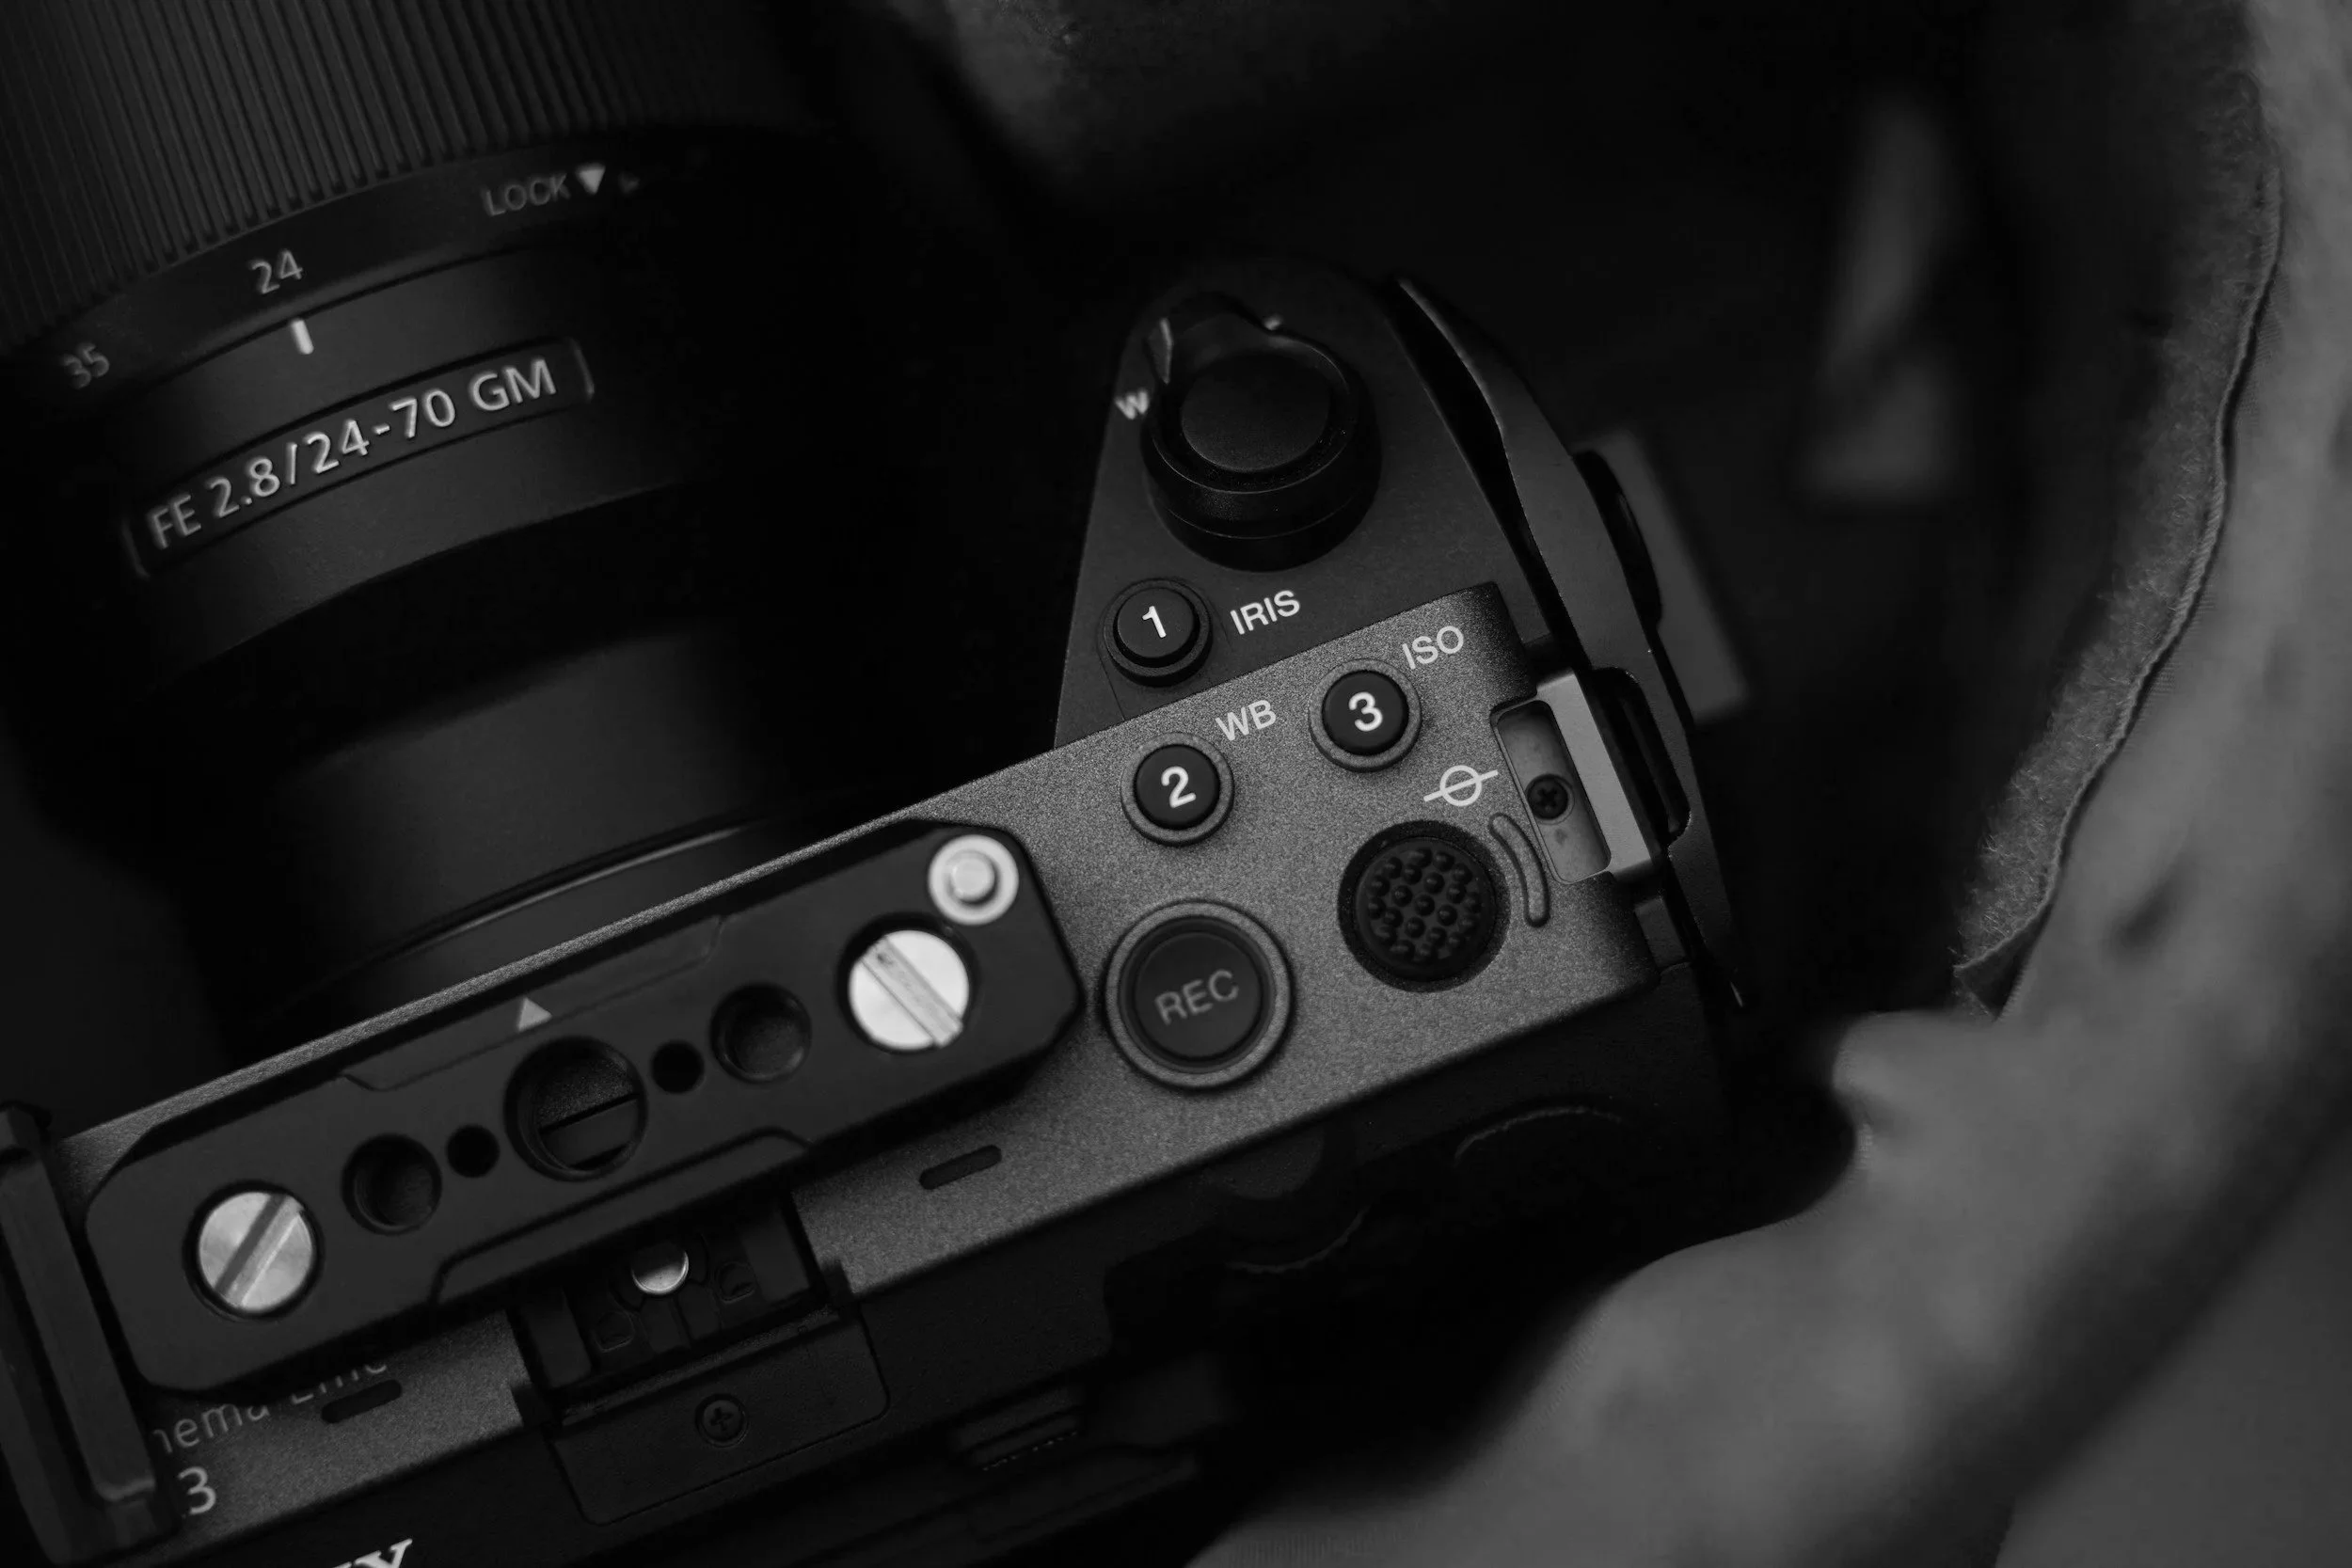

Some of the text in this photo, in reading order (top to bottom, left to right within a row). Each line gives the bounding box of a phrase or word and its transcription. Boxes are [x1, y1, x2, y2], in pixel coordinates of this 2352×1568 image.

[481, 171, 572, 217] LOCK
[247, 248, 304, 294] 24
[59, 342, 110, 388] 35
[146, 356, 557, 549] FE 2.8/24-70 GM
[1141, 605, 1168, 639] 1
[1229, 590, 1301, 636] IRIS
[1401, 625, 1465, 670] ISO
[1215, 699, 1277, 741] WB
[1347, 690, 1384, 732] 3
[1160, 765, 1197, 809] 2
[1153, 969, 1240, 1026] REC
[177, 1465, 217, 1516] 3
